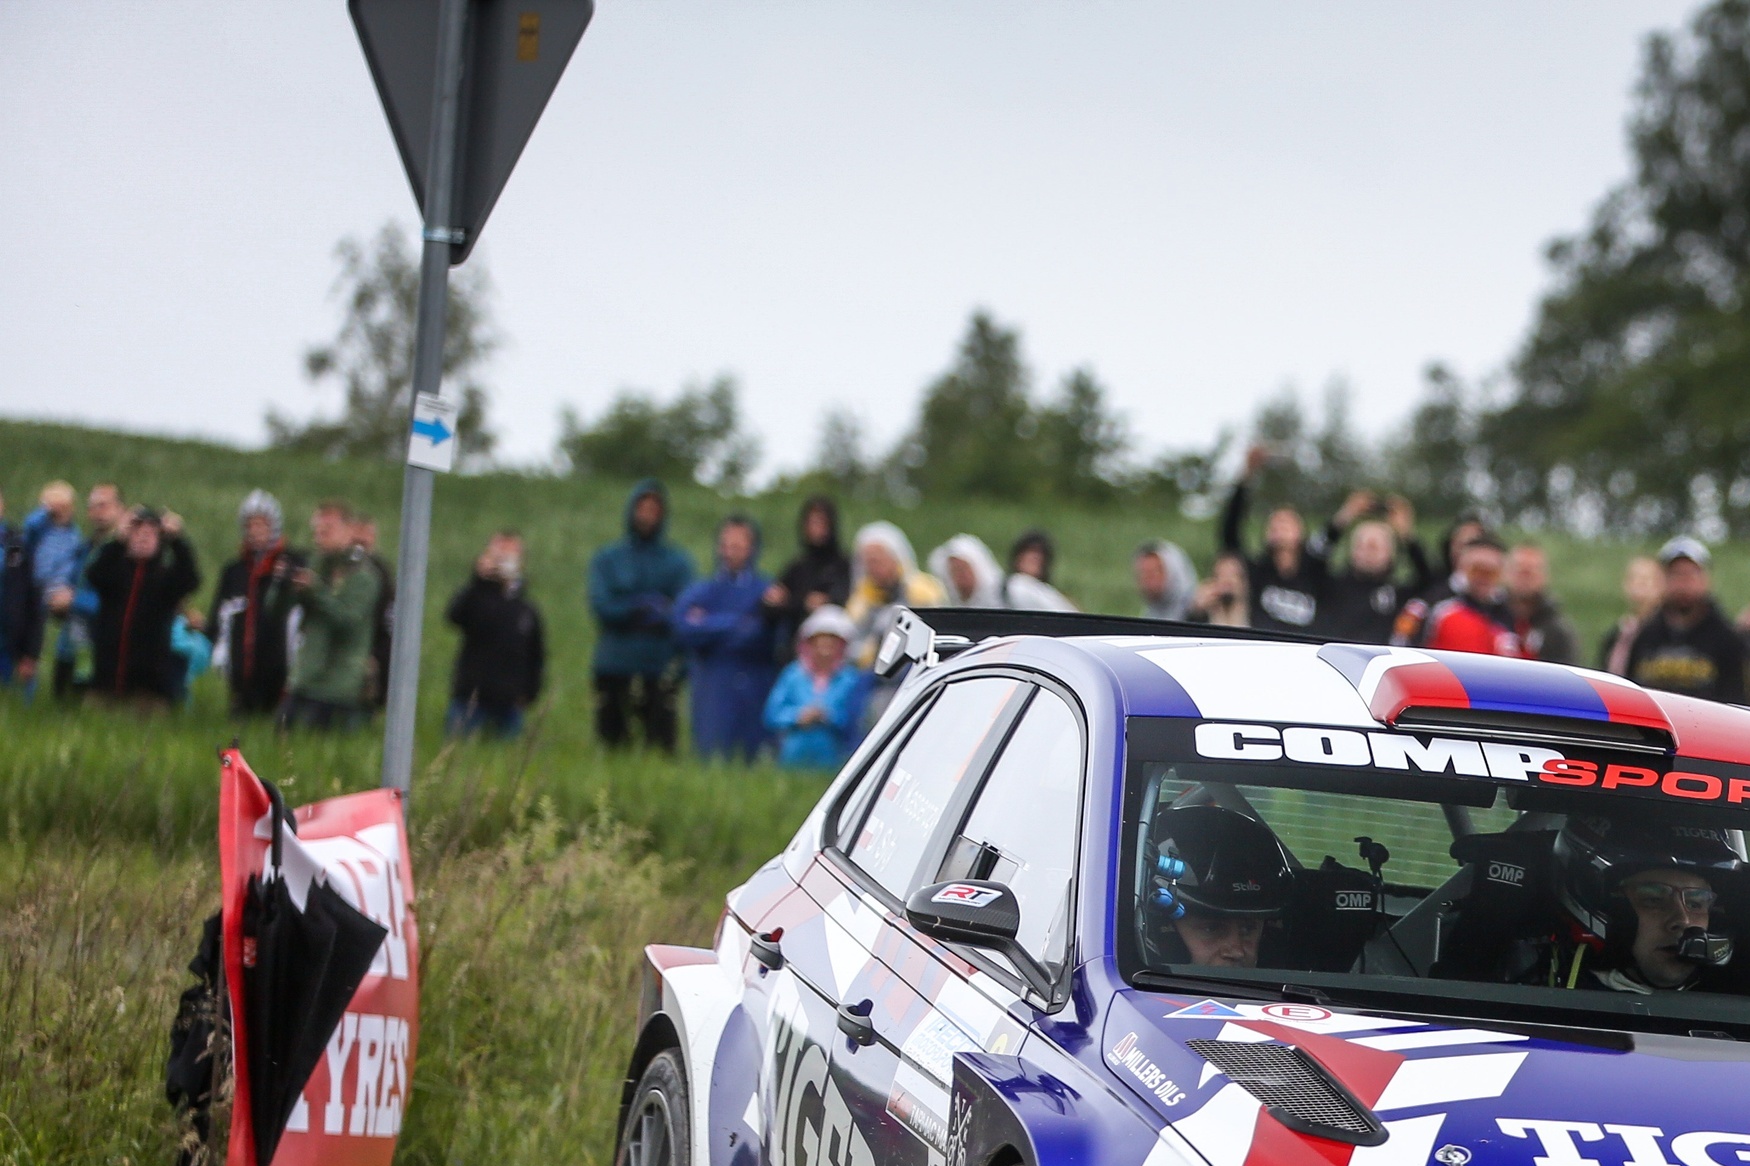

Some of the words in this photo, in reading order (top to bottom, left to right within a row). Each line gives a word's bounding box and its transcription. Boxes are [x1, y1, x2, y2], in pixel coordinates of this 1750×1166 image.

[1194, 722, 1568, 782] COMP
[1489, 863, 1525, 883] OMP
[1232, 882, 1261, 892] Stilo
[1335, 893, 1372, 907] OMP
[1121, 1046, 1167, 1089] MILLERS
[1153, 1080, 1187, 1107] OILS
